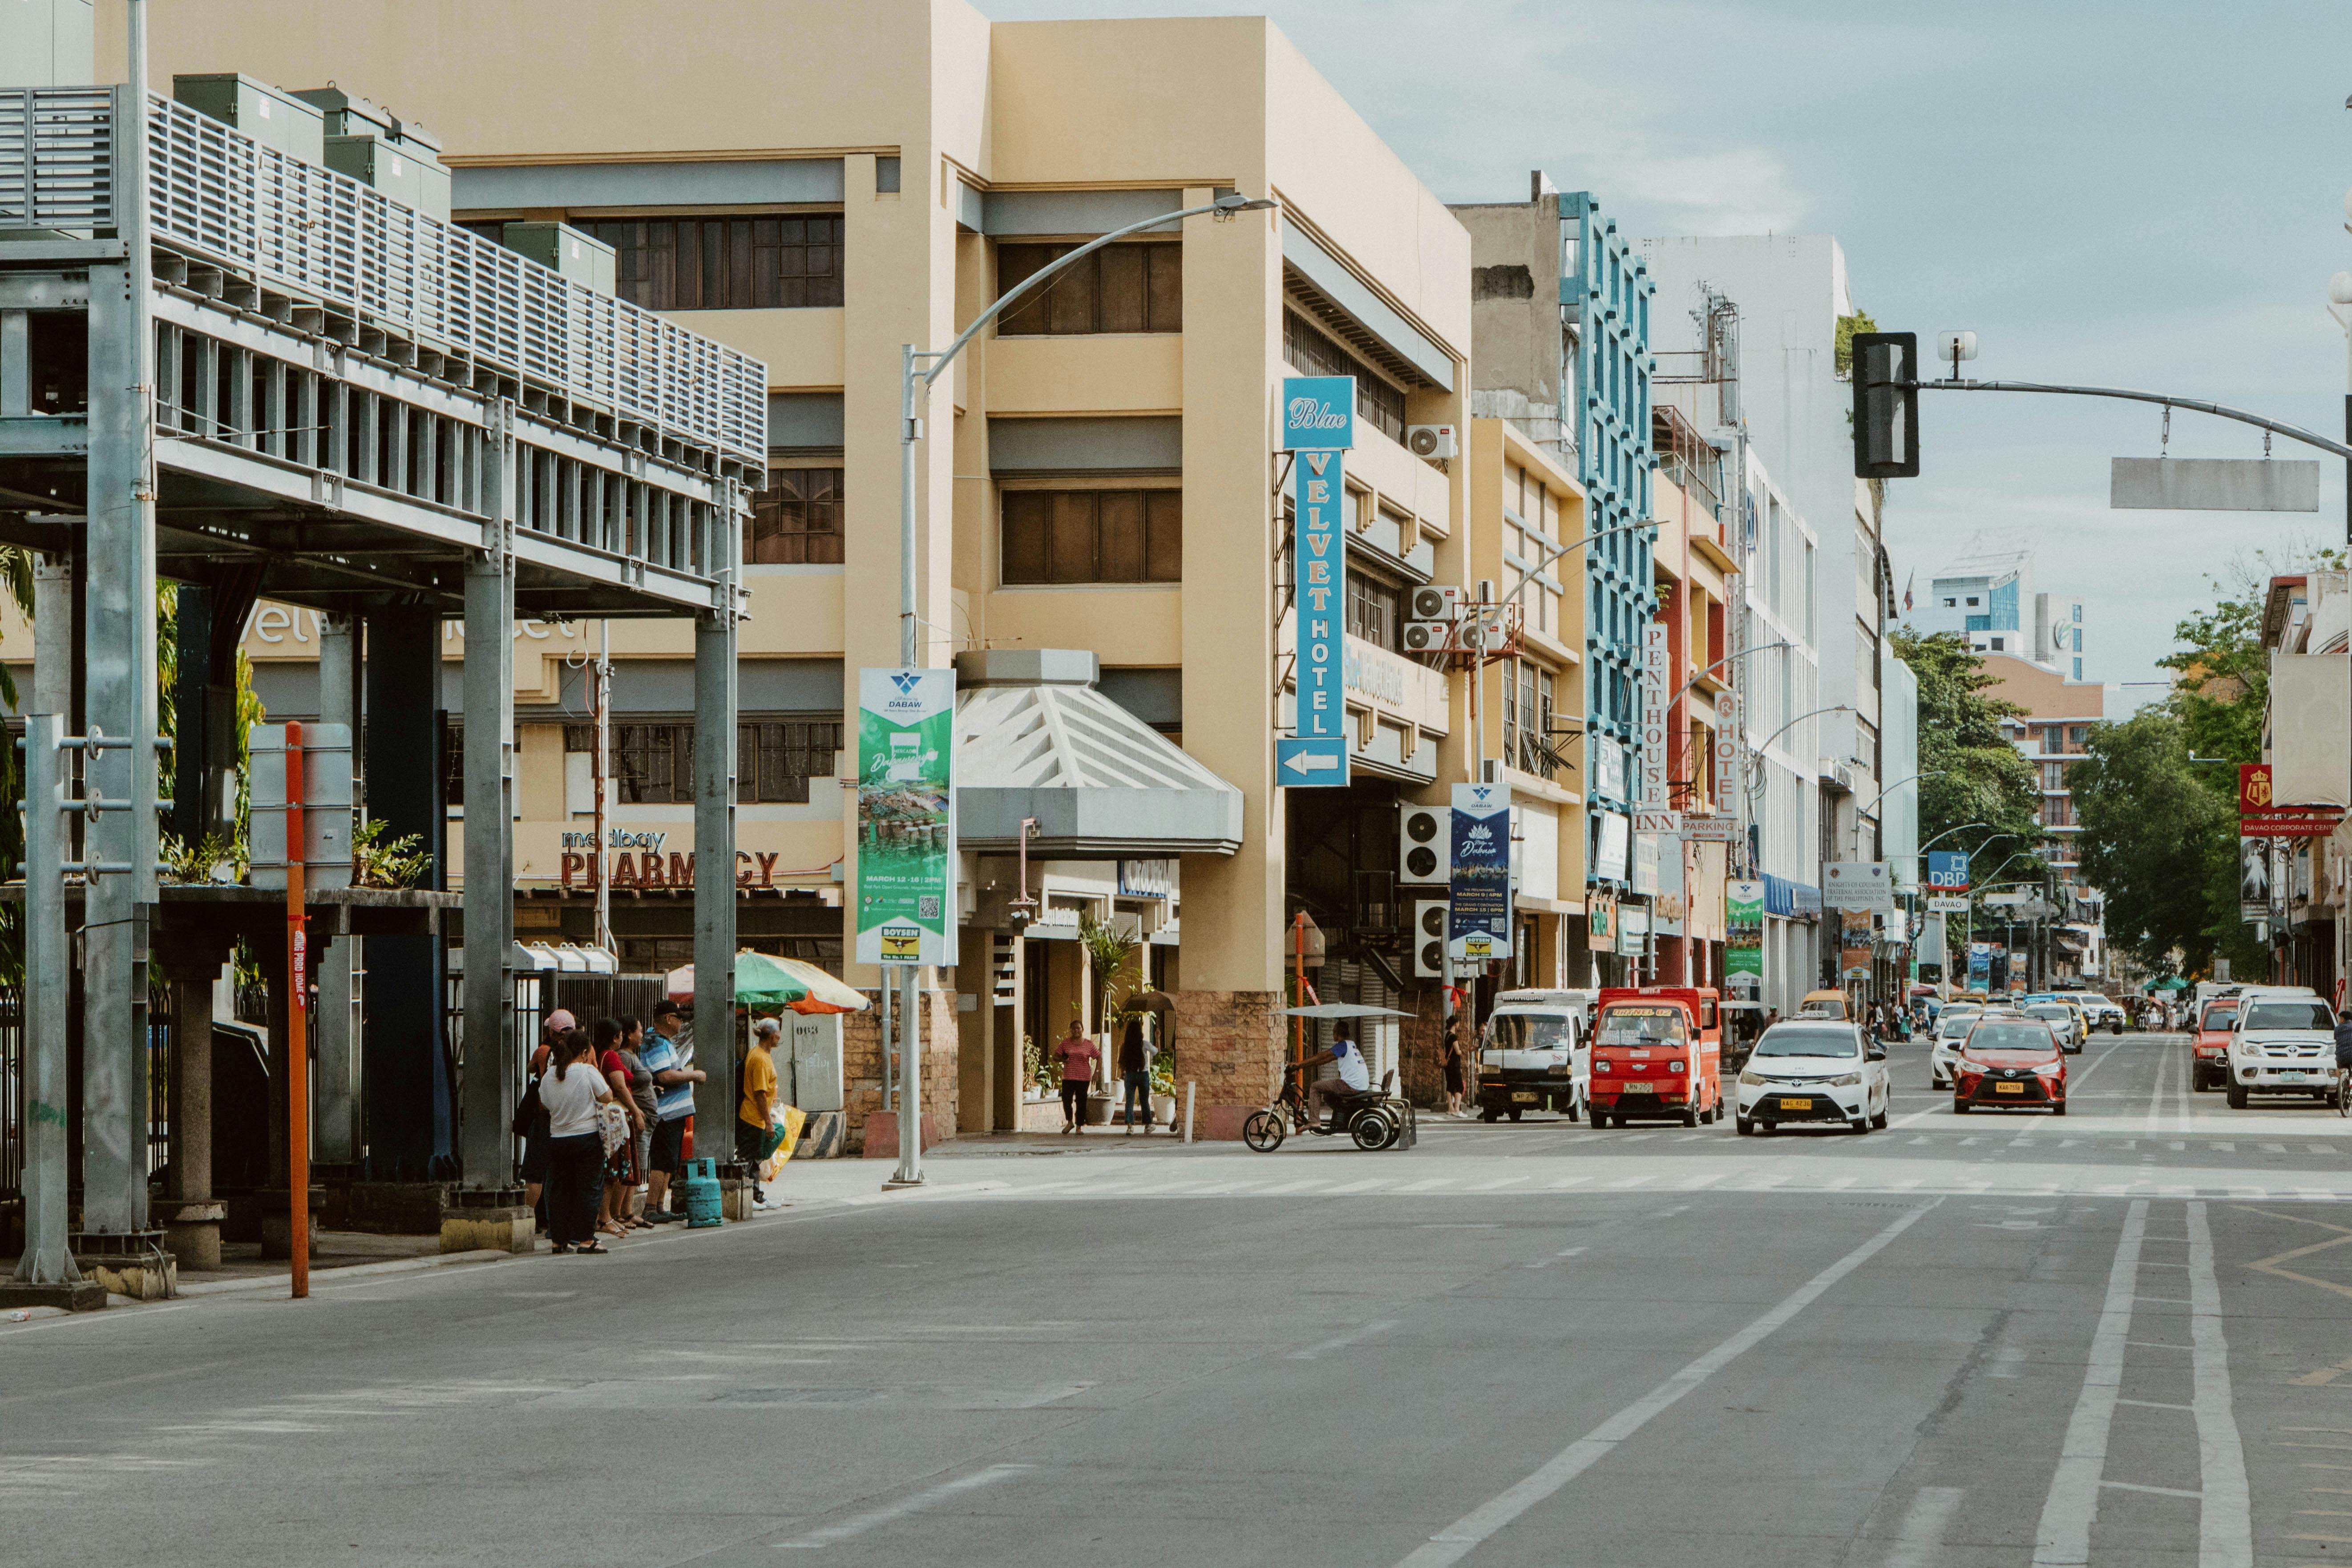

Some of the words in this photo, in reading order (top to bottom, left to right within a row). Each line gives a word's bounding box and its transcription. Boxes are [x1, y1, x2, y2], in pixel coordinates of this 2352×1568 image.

[1289, 397, 1347, 430] Blue
[1306, 453, 1331, 611] VELVET
[1311, 618, 1330, 735] HOTEL
[1646, 630, 1662, 803] PENTHOUSE
[1718, 723, 1734, 812] HOTEL
[1635, 815, 1674, 830] INN
[1683, 822, 1734, 831] PARKING
[562, 828, 668, 855] medbay
[561, 851, 779, 885] PHARMCY
[1931, 871, 1966, 886] DBP
[883, 928, 918, 937] BOYSEN
[295, 973, 304, 993] HOME
